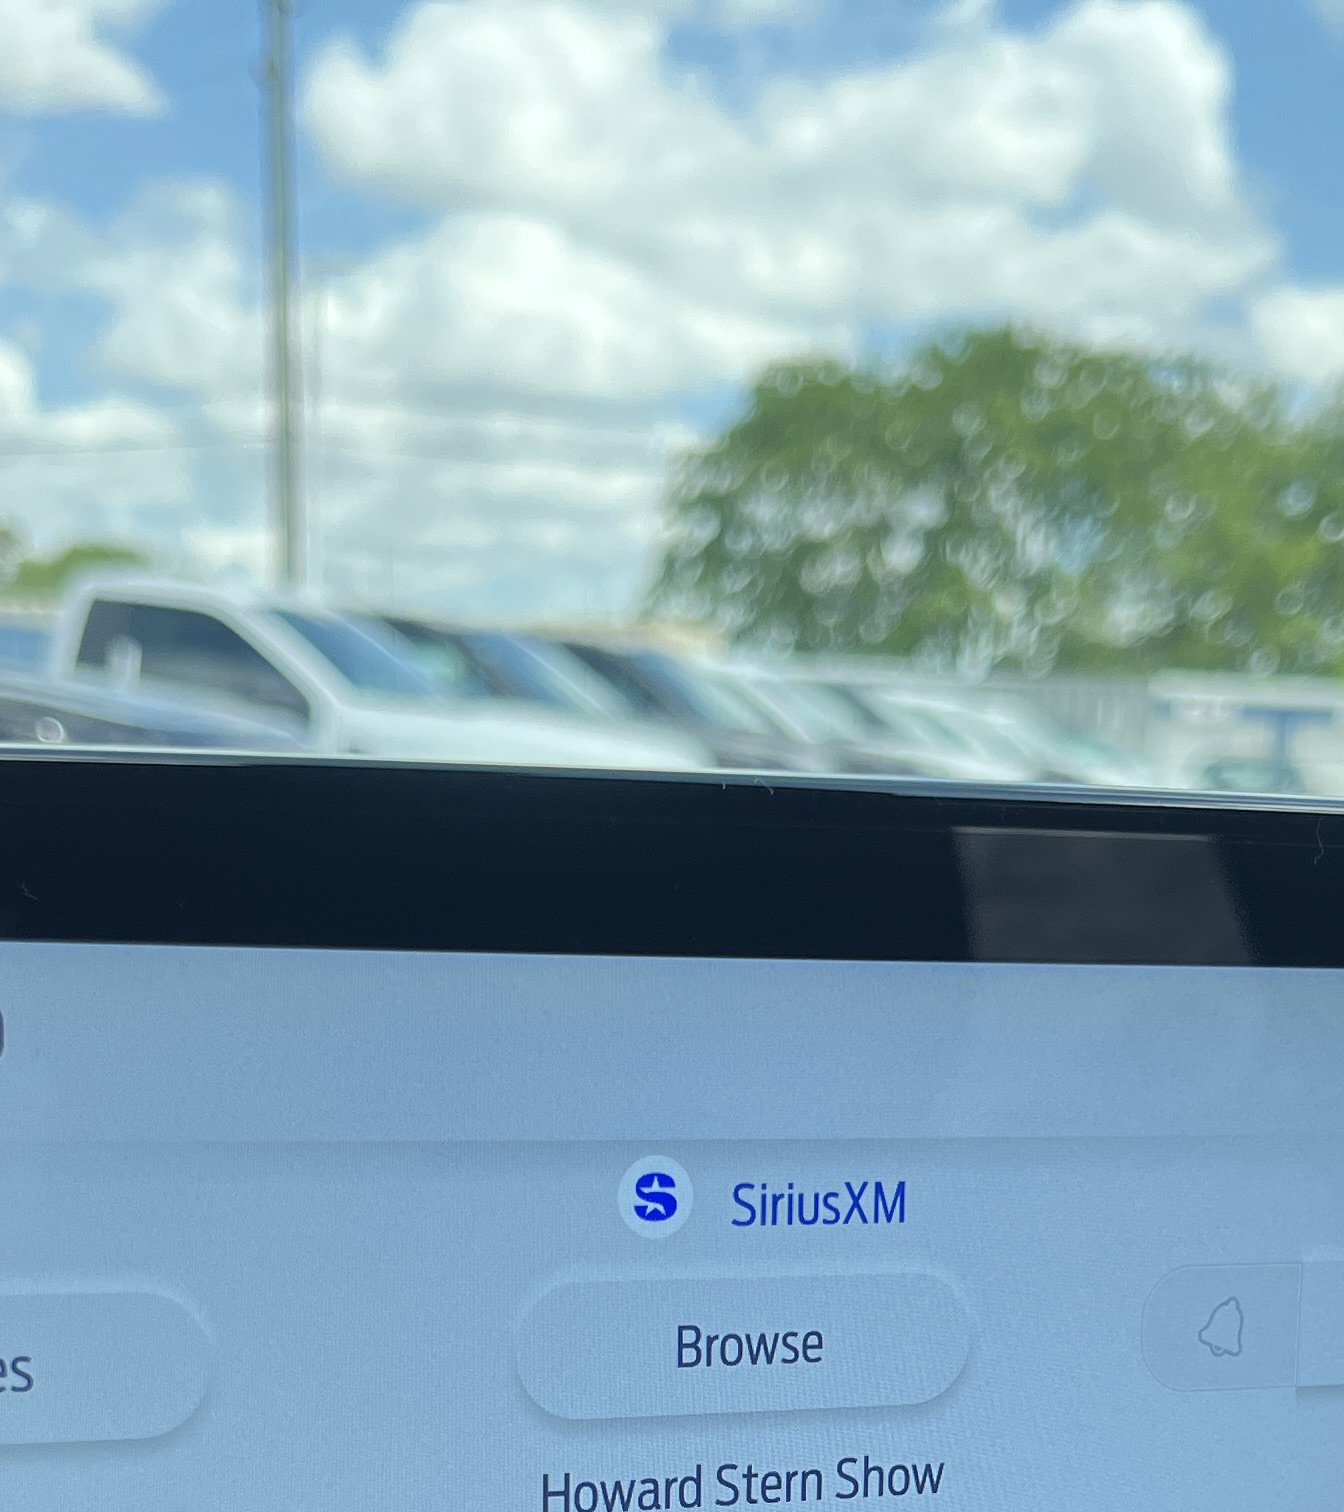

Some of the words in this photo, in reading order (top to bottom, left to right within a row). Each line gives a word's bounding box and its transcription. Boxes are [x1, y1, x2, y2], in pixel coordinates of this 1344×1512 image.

[731, 1181, 907, 1227] SiriusXM
[676, 1325, 824, 1368] Browse
[715, 1465, 824, 1508] Stern
[835, 1456, 946, 1500] Show
